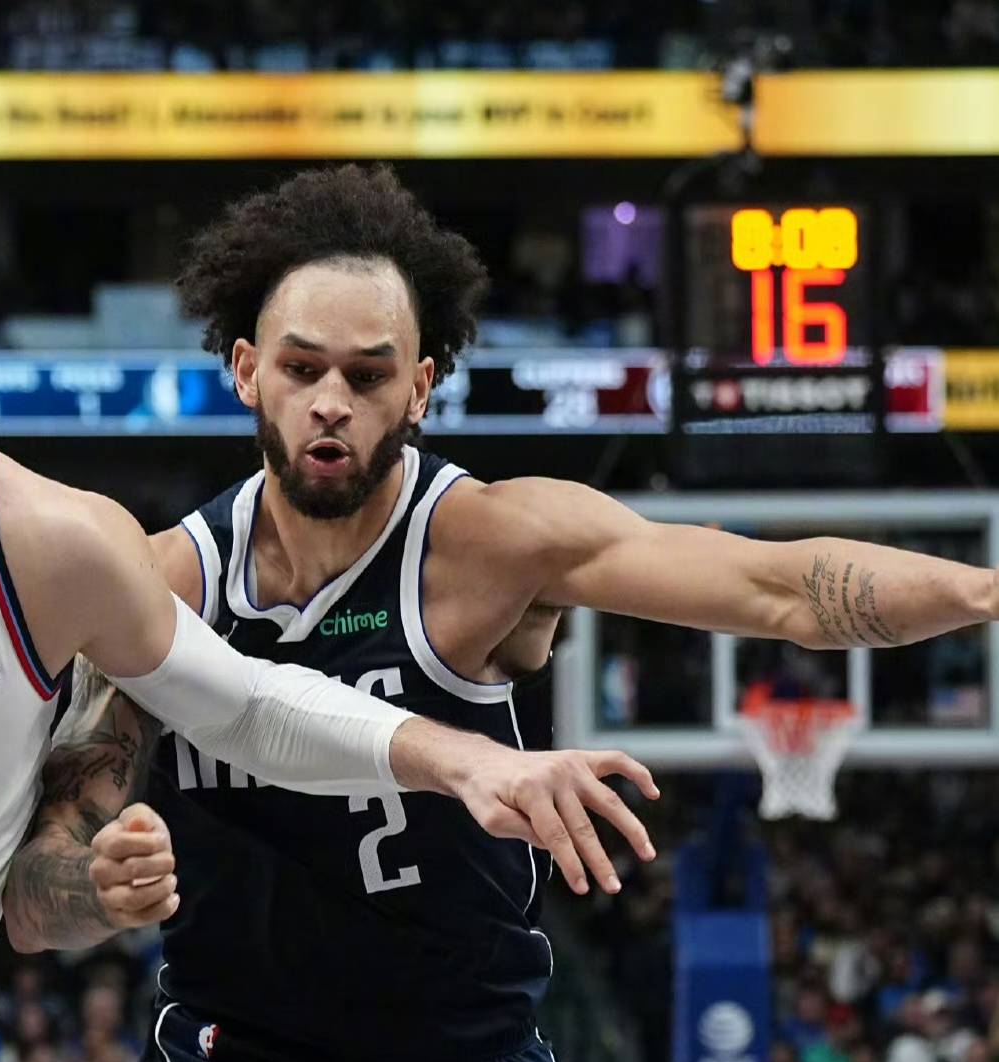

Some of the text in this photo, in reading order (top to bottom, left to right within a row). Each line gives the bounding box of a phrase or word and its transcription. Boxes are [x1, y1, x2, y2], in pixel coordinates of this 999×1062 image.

[751, 265, 848, 368] 16
[320, 608, 388, 636] chime
[347, 788, 422, 895] 2
